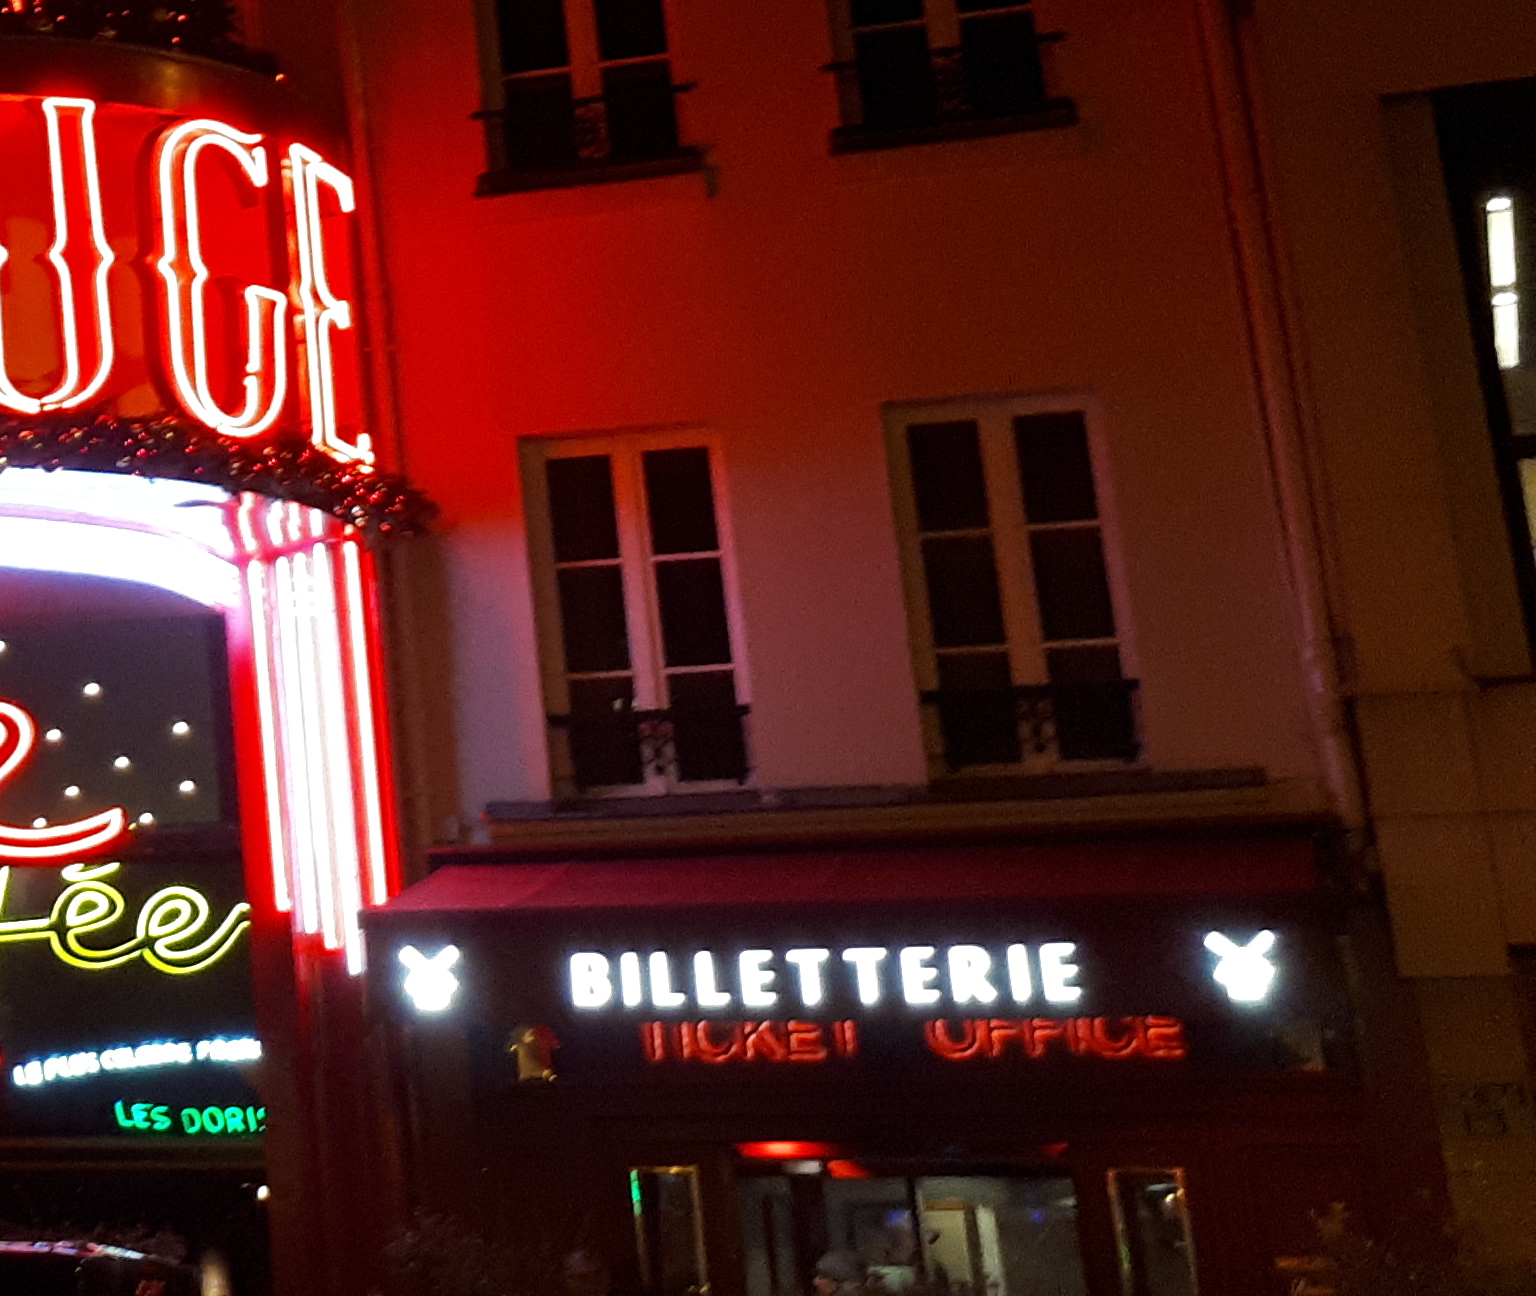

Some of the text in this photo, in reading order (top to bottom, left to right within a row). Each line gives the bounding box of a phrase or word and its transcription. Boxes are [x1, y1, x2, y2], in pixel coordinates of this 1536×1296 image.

[569, 940, 1083, 1009] BILLETTERIE
[640, 1015, 1186, 1062] TICKET OFFICE
[114, 1100, 172, 1131] LES
